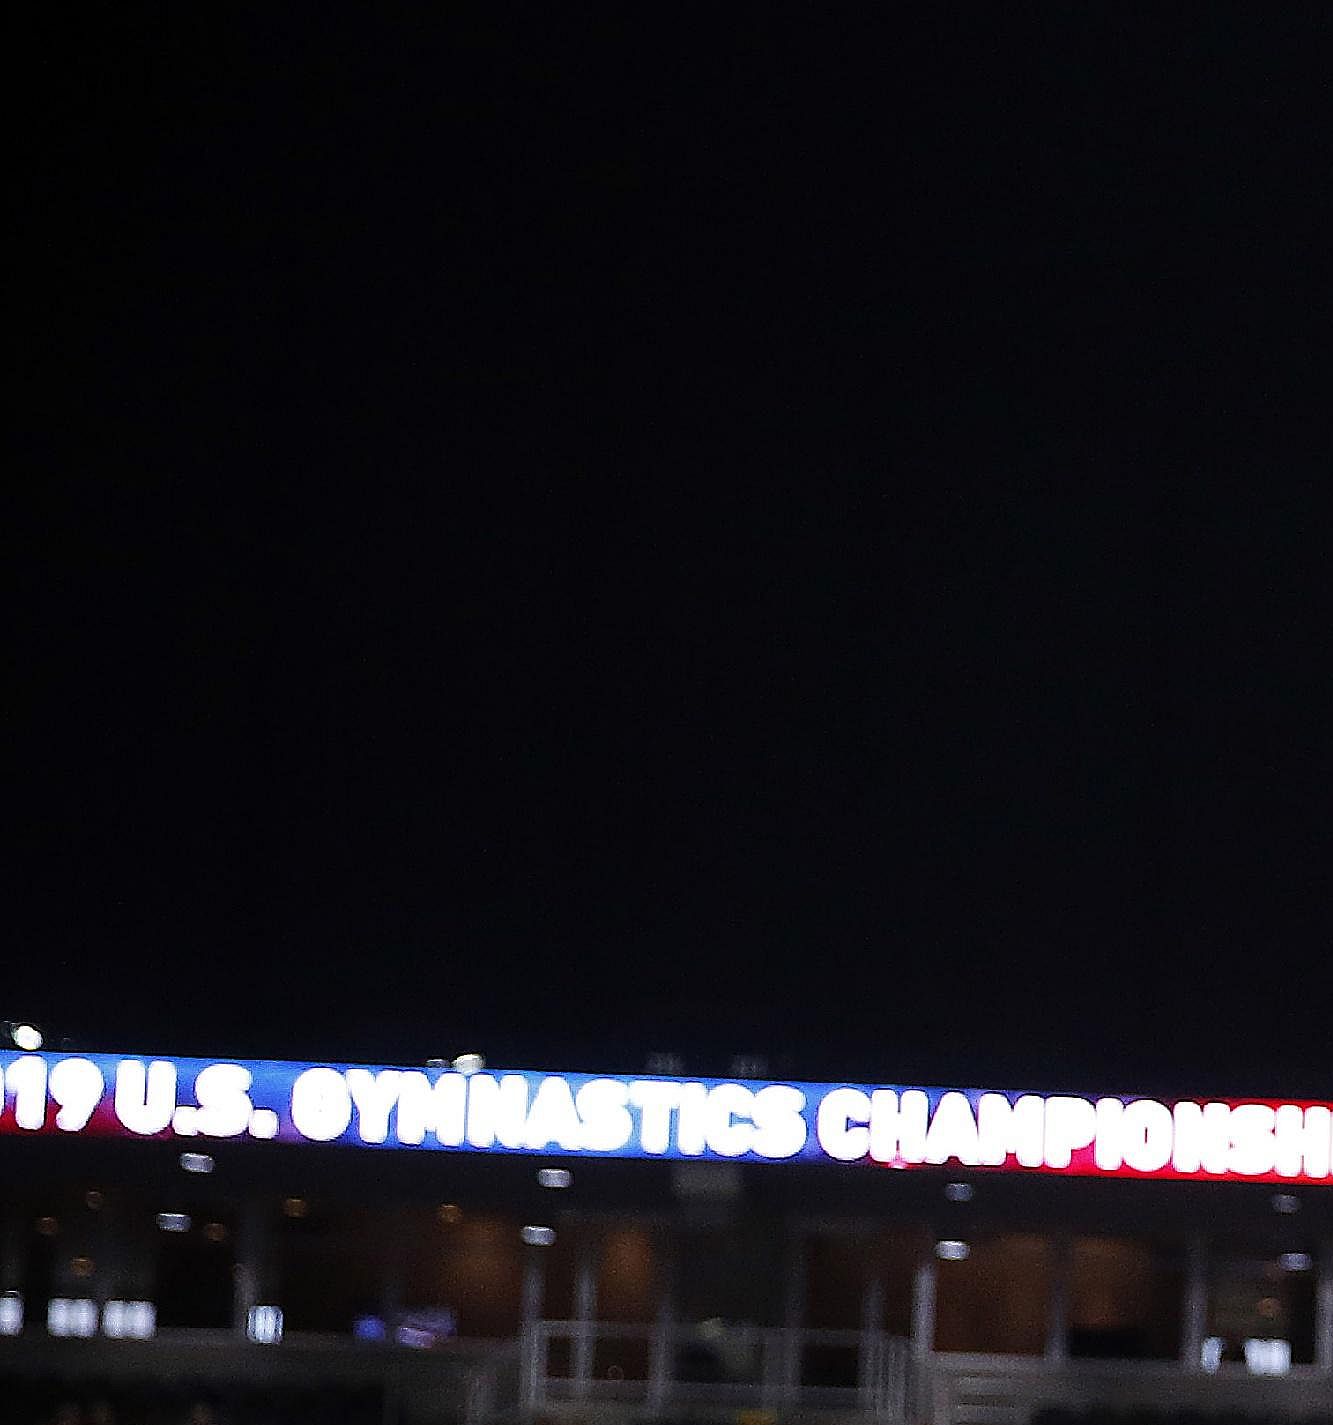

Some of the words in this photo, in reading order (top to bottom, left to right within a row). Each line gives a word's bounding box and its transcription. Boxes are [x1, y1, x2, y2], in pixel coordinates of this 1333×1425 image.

[0, 1054, 105, 1132] 19
[114, 1058, 280, 1140] U.S.
[291, 1066, 808, 1160] GYMNASTICS
